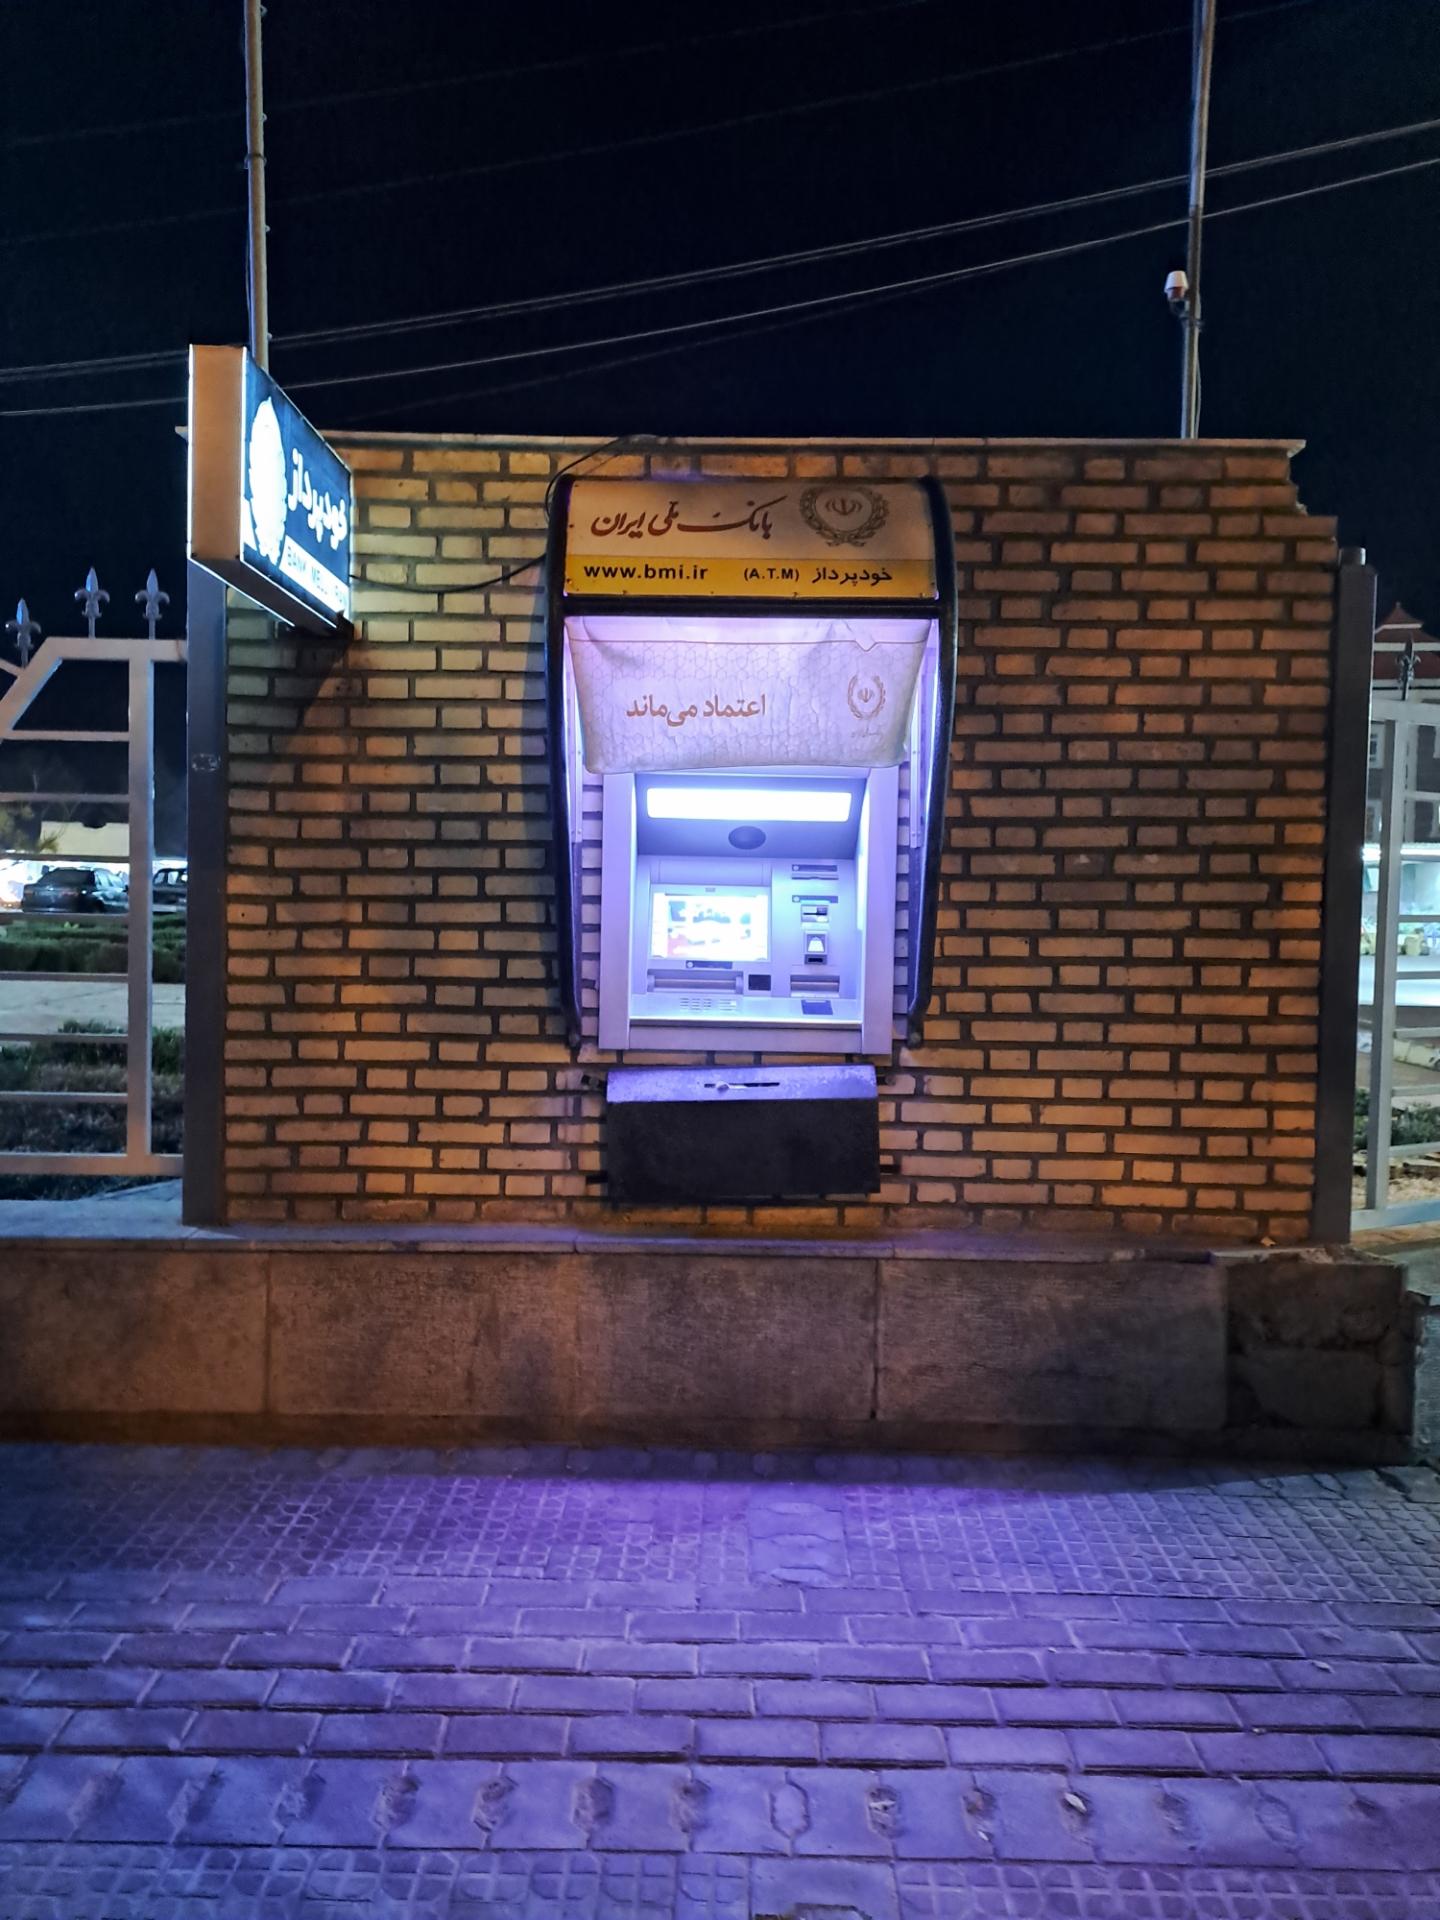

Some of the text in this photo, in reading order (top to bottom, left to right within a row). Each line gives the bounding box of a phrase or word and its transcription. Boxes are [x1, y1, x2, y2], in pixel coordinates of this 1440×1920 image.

[287, 447, 348, 551] خودپرداز
[590, 510, 646, 539] ایران
[677, 495, 788, 540] بانک
[583, 563, 709, 581] www.bmi.ir
[744, 566, 893, 587] خودپرداز (A.T.M)
[702, 694, 766, 718] اعتماد
